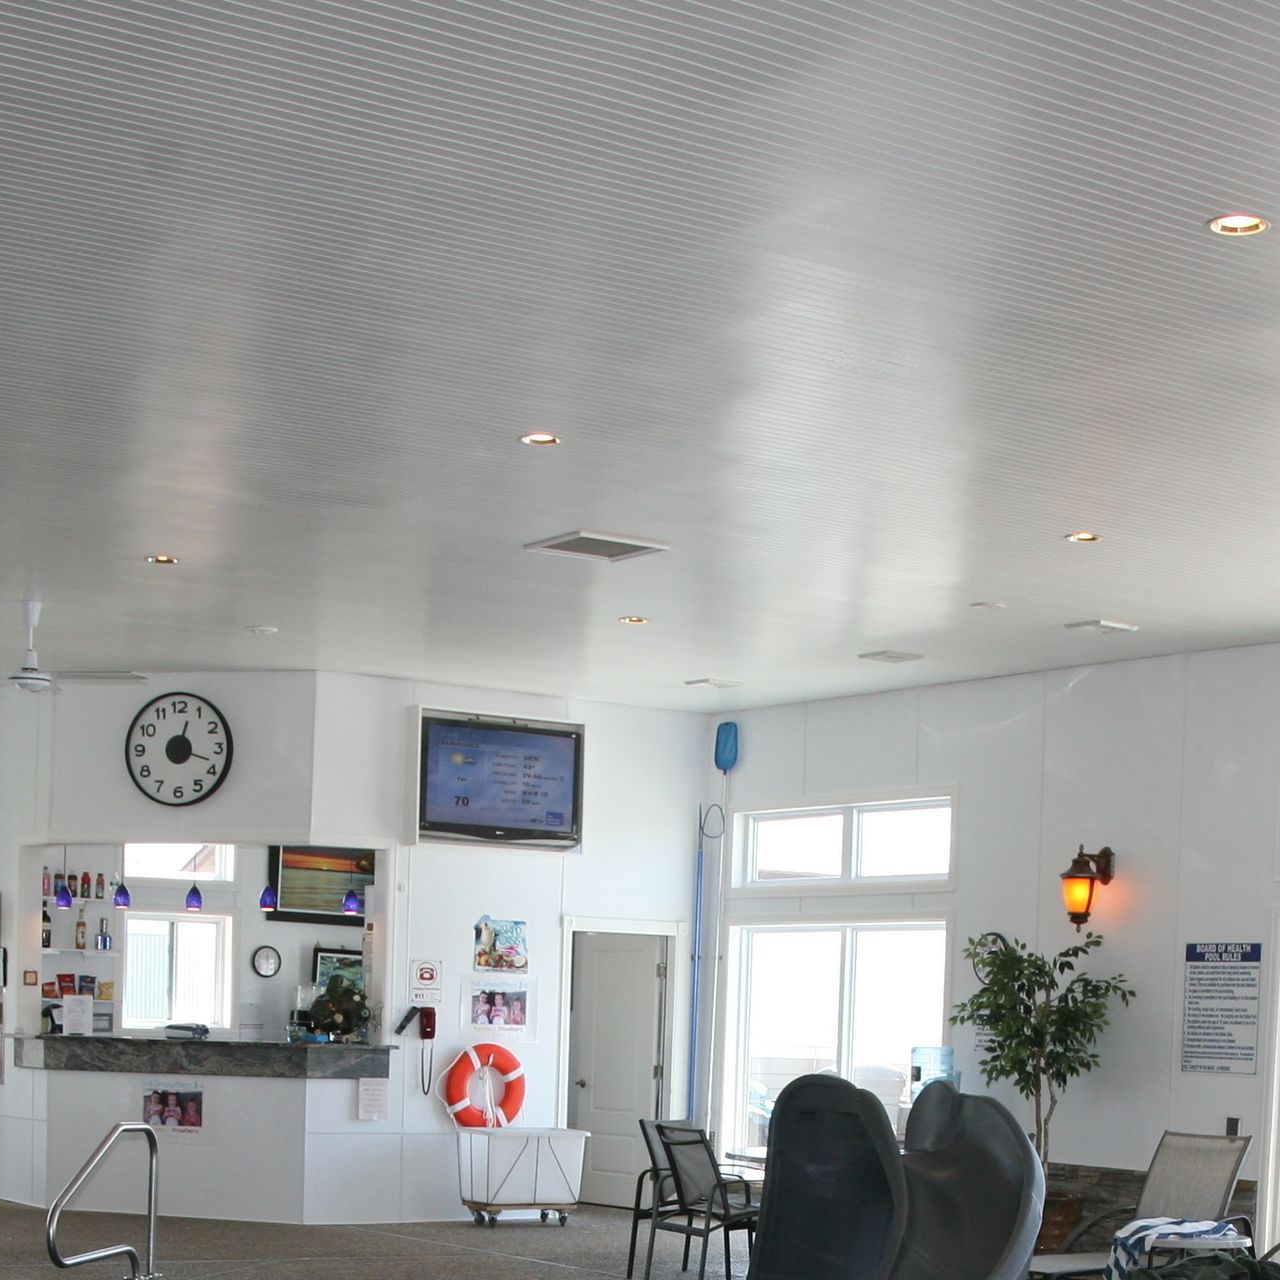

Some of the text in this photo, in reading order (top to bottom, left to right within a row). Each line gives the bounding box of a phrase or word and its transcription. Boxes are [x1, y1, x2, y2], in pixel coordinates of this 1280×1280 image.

[172, 701, 188, 713] 12
[197, 706, 201, 719] 1
[155, 708, 166, 720] 11
[140, 724, 156, 737] 10
[208, 722, 218, 734] 2
[134, 744, 145, 757] 9
[213, 743, 223, 755] 3
[140, 765, 151, 778] 8
[207, 764, 216, 776] 4
[155, 780, 164, 792] 7
[173, 786, 184, 798] 6
[193, 780, 203, 792] 5
[453, 796, 470, 807] 70
[1197, 944, 1251, 953] BOARD OF HEALTH
[1205, 953, 1241, 961] POOL RULES
